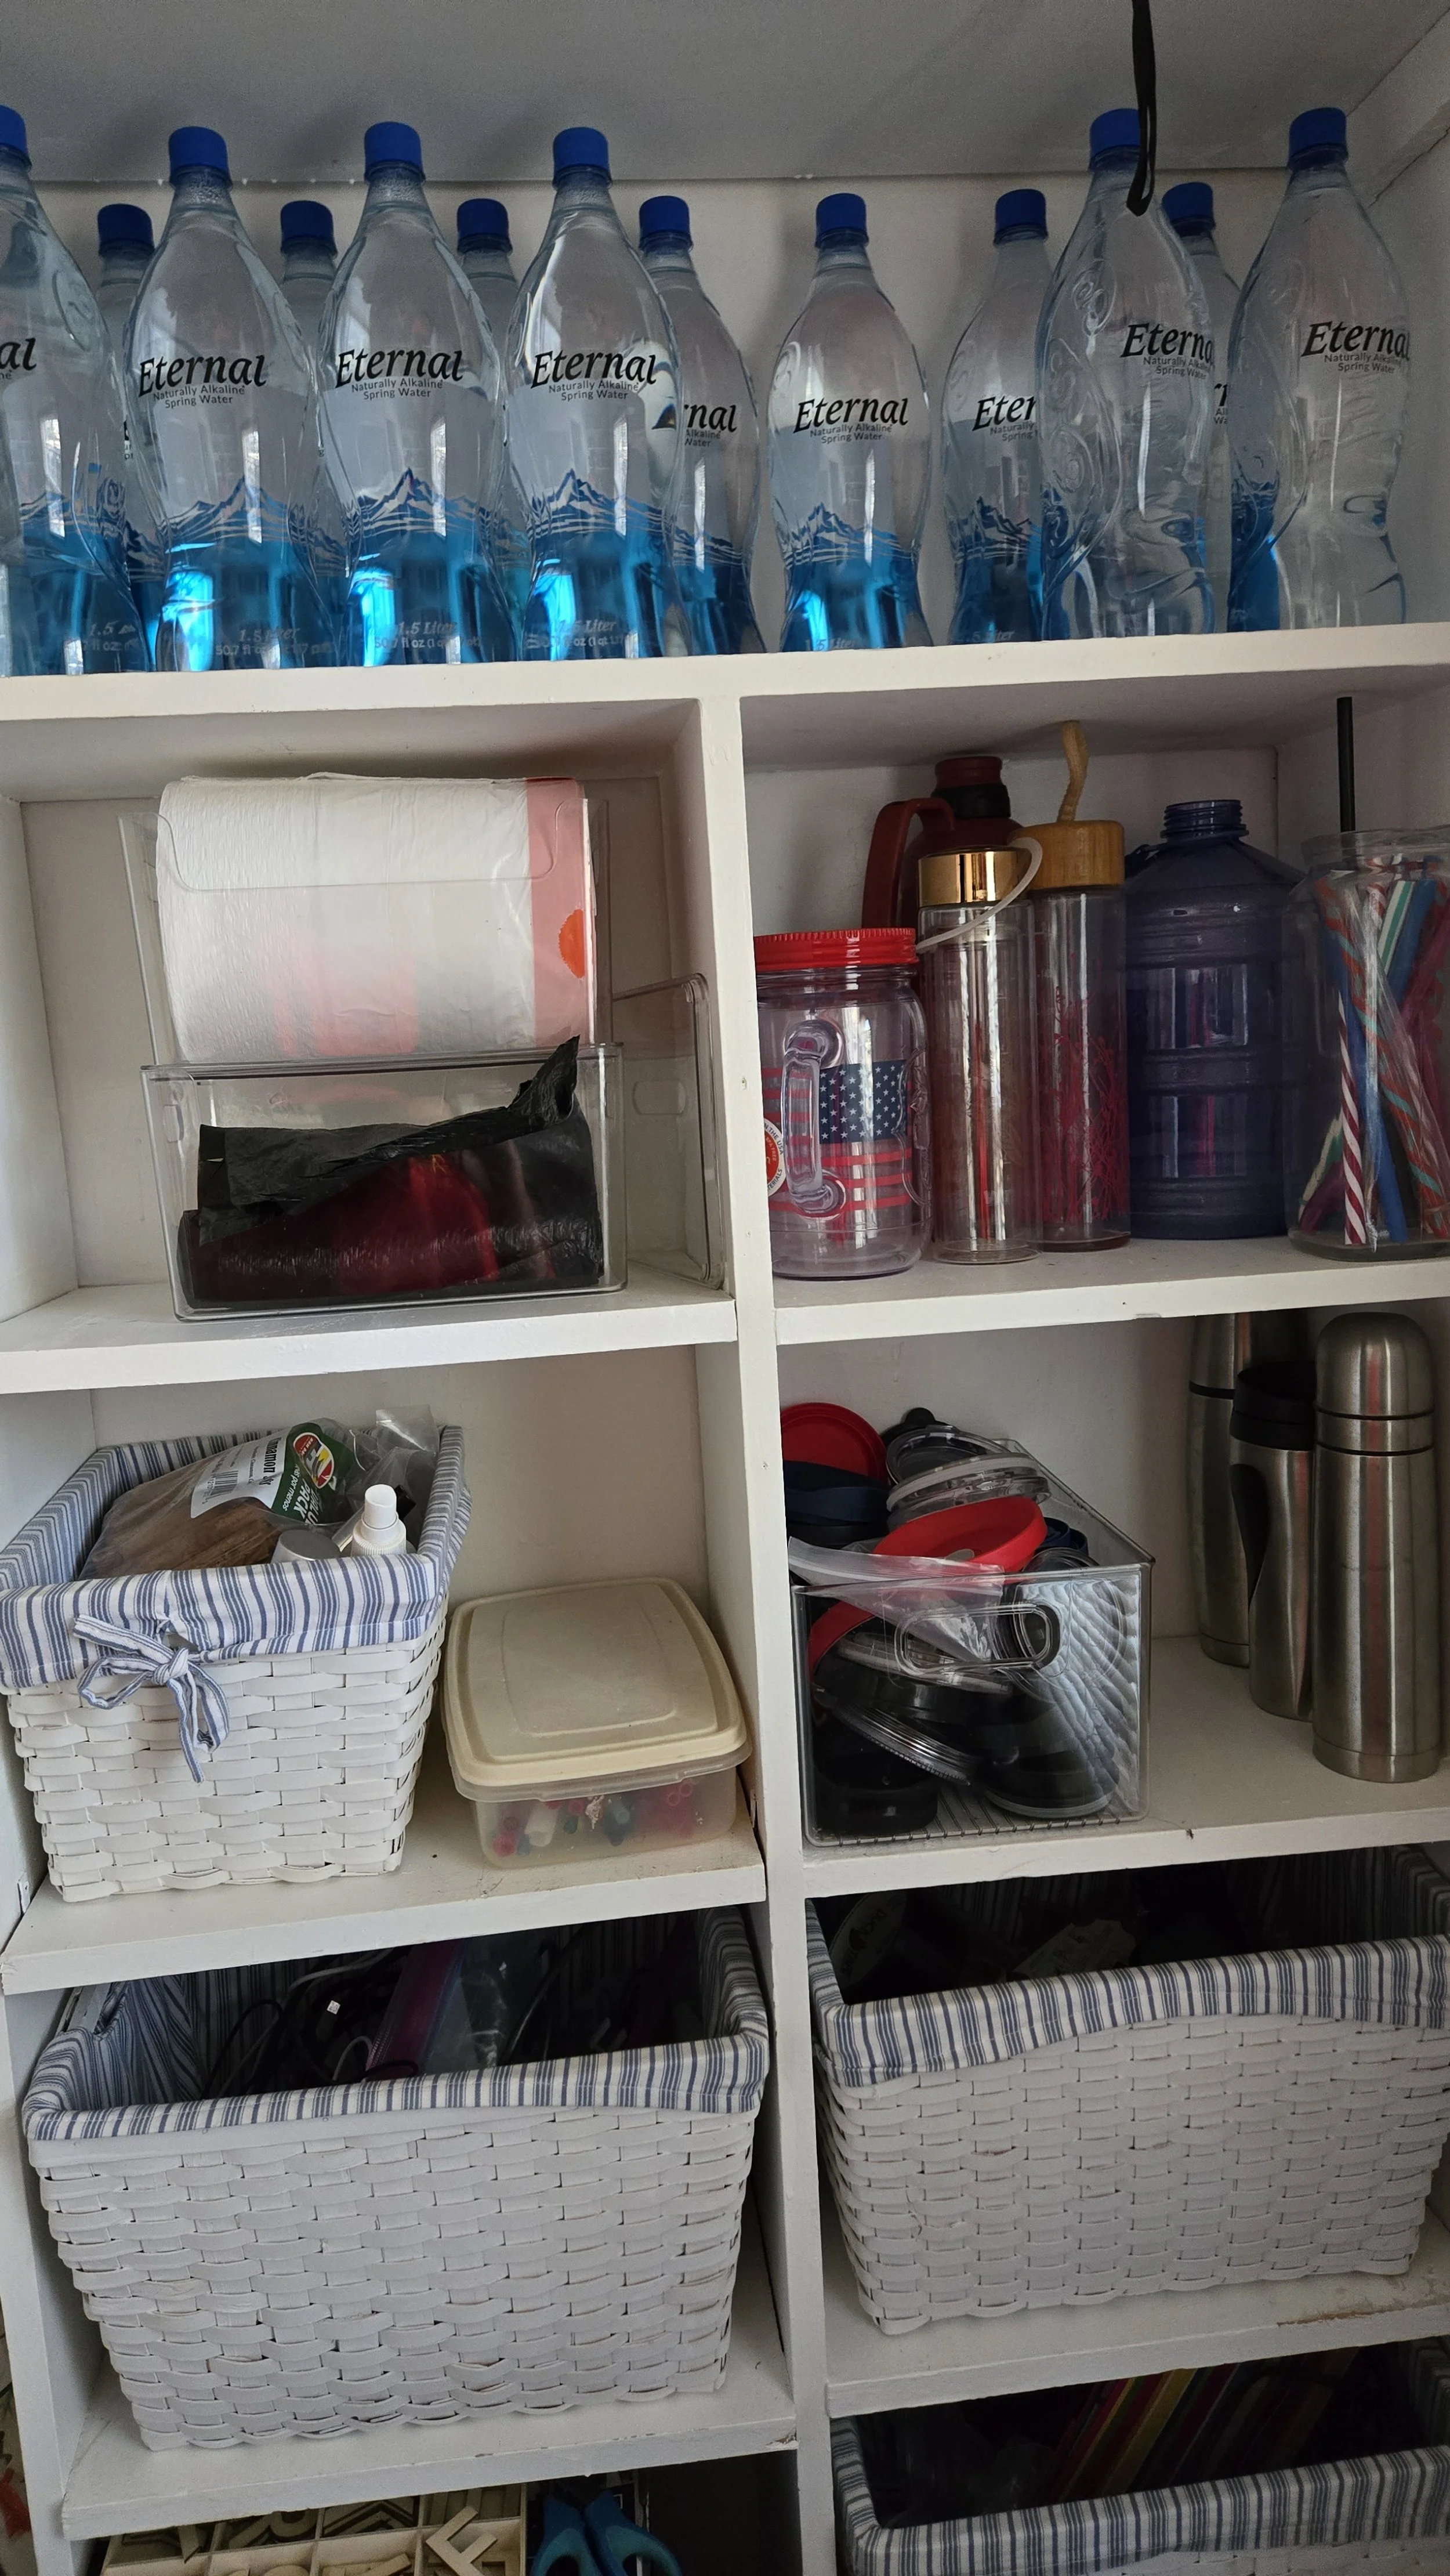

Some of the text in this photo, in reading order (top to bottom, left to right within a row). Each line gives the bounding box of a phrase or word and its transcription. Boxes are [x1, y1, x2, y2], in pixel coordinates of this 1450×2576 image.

[1300, 321, 1409, 361] Eternal
[1143, 356, 1187, 368] Naturally
[1324, 353, 1372, 363] Naturally
[335, 348, 463, 388] Eternal
[531, 350, 657, 389] Eternal
[1156, 365, 1186, 377] Spring
[1338, 363, 1369, 372] Spring
[139, 354, 266, 397] Eternal
[351, 379, 396, 392] Naturally
[548, 381, 595, 394] Naturally
[154, 386, 197, 401] Naturally
[364, 388, 431, 401] Spring Water
[561, 390, 628, 402] Spring Water
[165, 395, 233, 408] Spring Water
[793, 397, 908, 433] Eternal
[972, 396, 1036, 431] Eter
[810, 424, 853, 437] Naturally
[821, 433, 882, 444] Spring Water
[585, 619, 616, 632] Liter
[282, 1488, 295, 1511] menos
[293, 1478, 311, 1519] PACK
